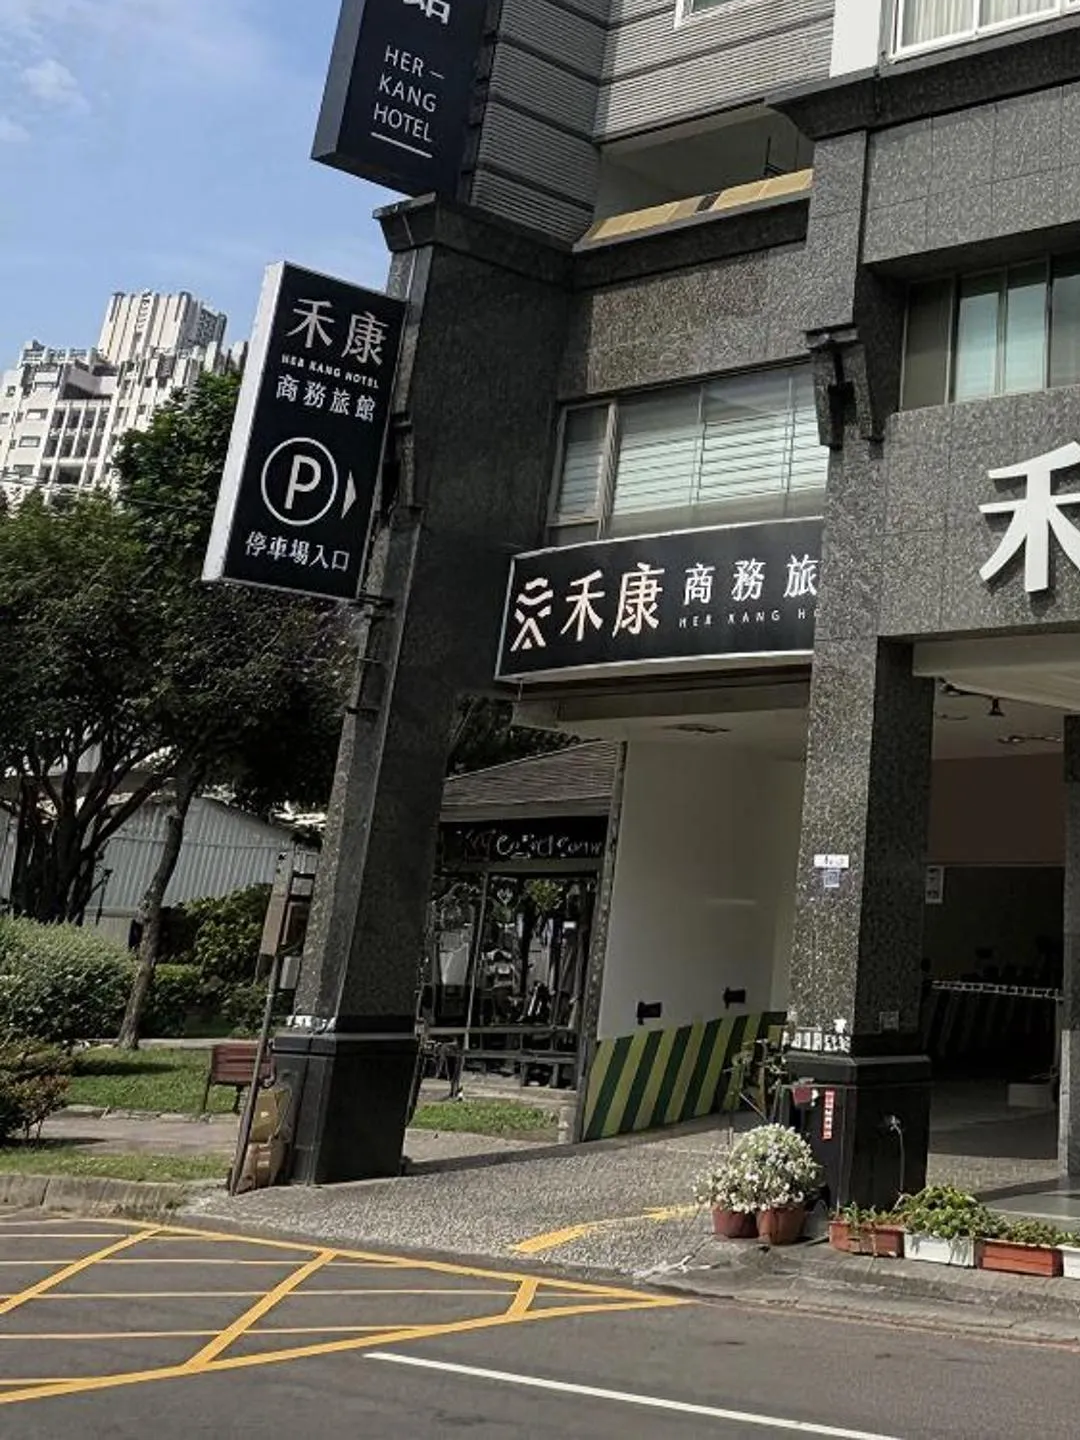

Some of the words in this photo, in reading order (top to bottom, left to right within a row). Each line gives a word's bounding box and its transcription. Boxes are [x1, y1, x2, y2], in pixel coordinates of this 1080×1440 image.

[384, 44, 424, 77] HER
[379, 73, 437, 112] KANG
[373, 102, 433, 142] HOTEL
[285, 298, 389, 366] 禾康
[281, 353, 305, 368] HER
[308, 360, 342, 377] KANG
[344, 371, 380, 389] HOTEL
[276, 374, 376, 423] 商務旅館
[284, 454, 322, 511] P
[245, 530, 351, 573] 停車場入口
[560, 561, 666, 643] 禾康
